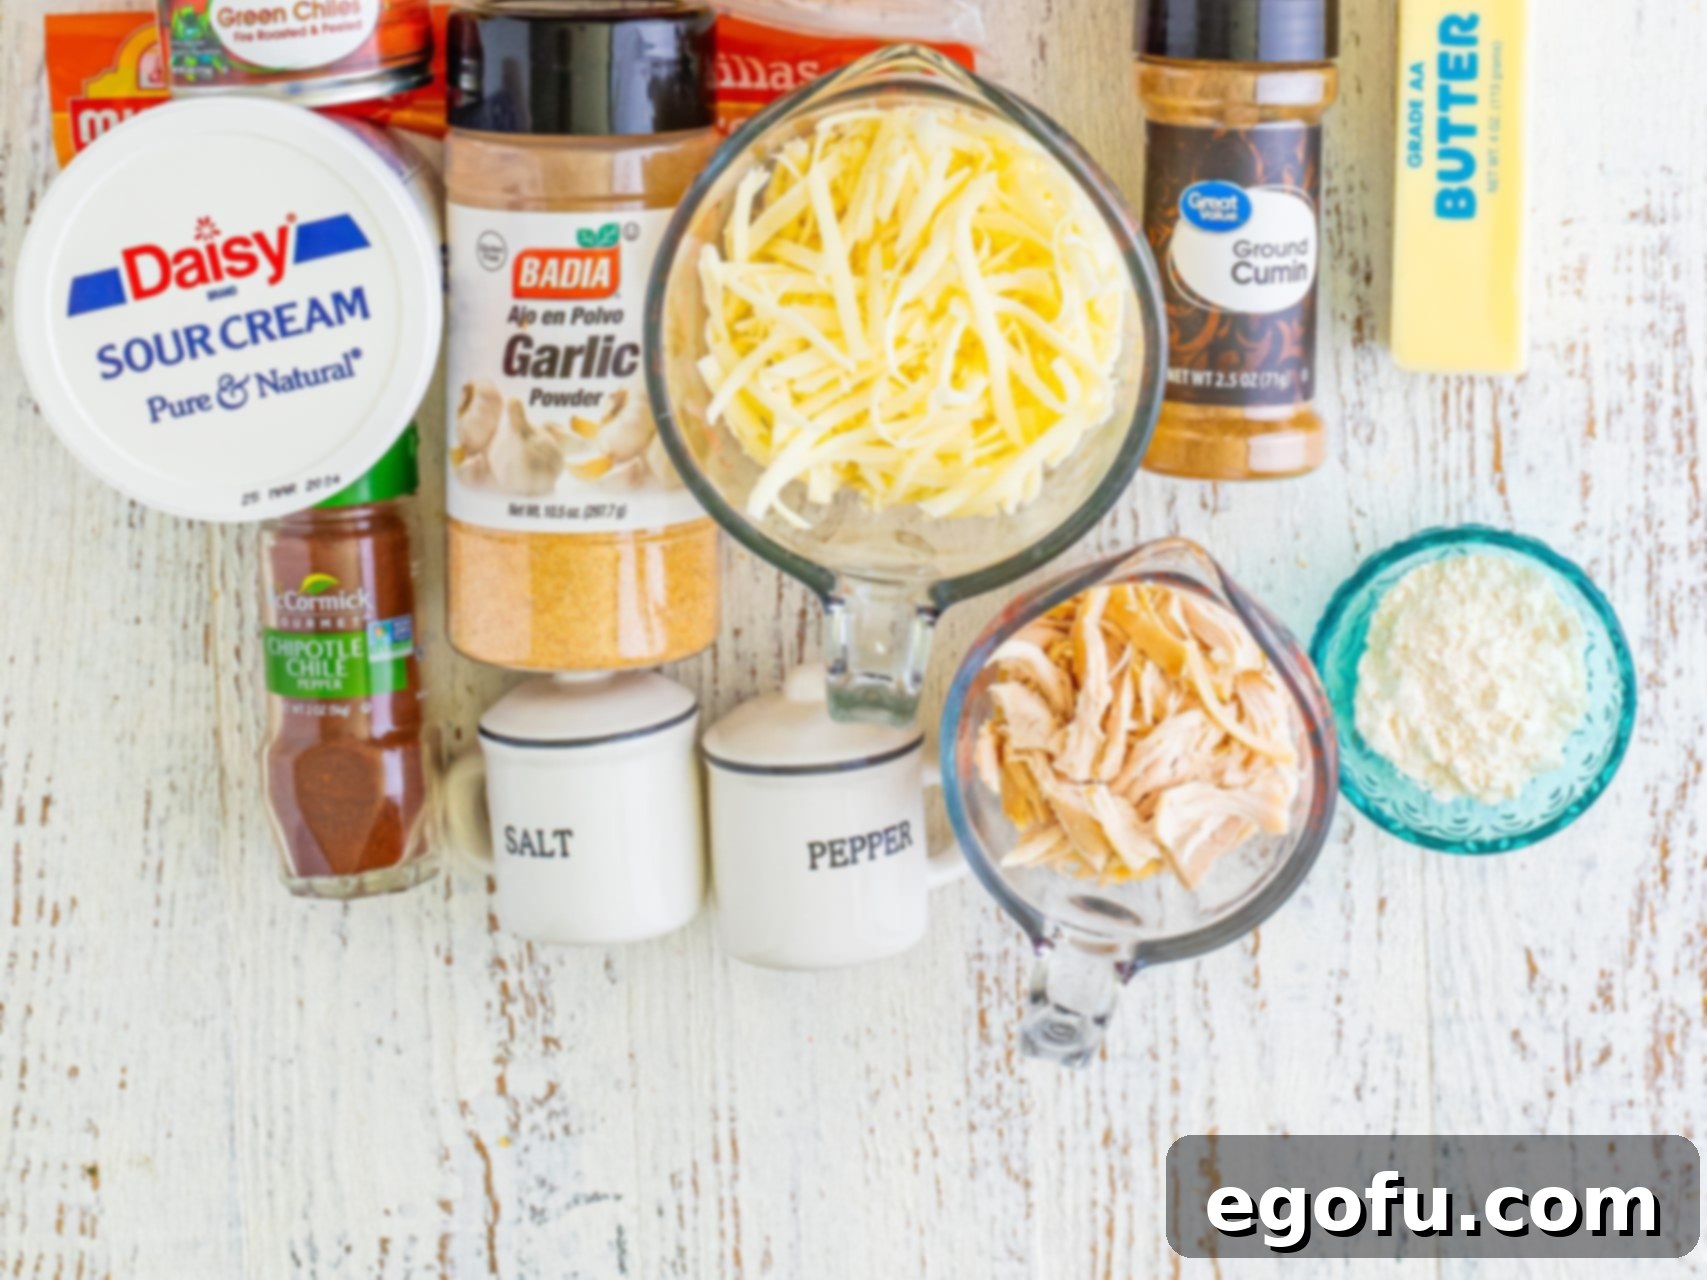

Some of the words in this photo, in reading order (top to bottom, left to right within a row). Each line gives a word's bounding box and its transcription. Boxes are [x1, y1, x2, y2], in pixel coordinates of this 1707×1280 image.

[217, 6, 287, 28] Green
[257, 26, 308, 41] Roasted
[1409, 61, 1425, 92] AA
[1435, 12, 1481, 221] BUTTER
[1407, 100, 1424, 168] GRADE
[1188, 192, 1238, 211] Great
[121, 218, 290, 302] Daisy
[1233, 239, 1308, 259] Ground
[519, 256, 611, 289] BADIA
[1230, 260, 1308, 286] Cumin
[507, 306, 537, 328] Ajo
[541, 309, 565, 325] en
[570, 306, 624, 326] Polvo
[96, 323, 216, 381] SOUR
[218, 286, 371, 350] CREAM
[502, 333, 640, 380] Garlic
[146, 393, 212, 423] Pure
[215, 373, 251, 410] &
[255, 350, 358, 399] Natural
[1191, 370, 1213, 387] WT
[1215, 371, 1237, 388] 2.5
[529, 388, 603, 407] Powder
[268, 636, 364, 658] CHIPOTLE
[286, 658, 349, 677] CHILE
[504, 825, 574, 859] SALT
[807, 819, 914, 871] PEPPER
